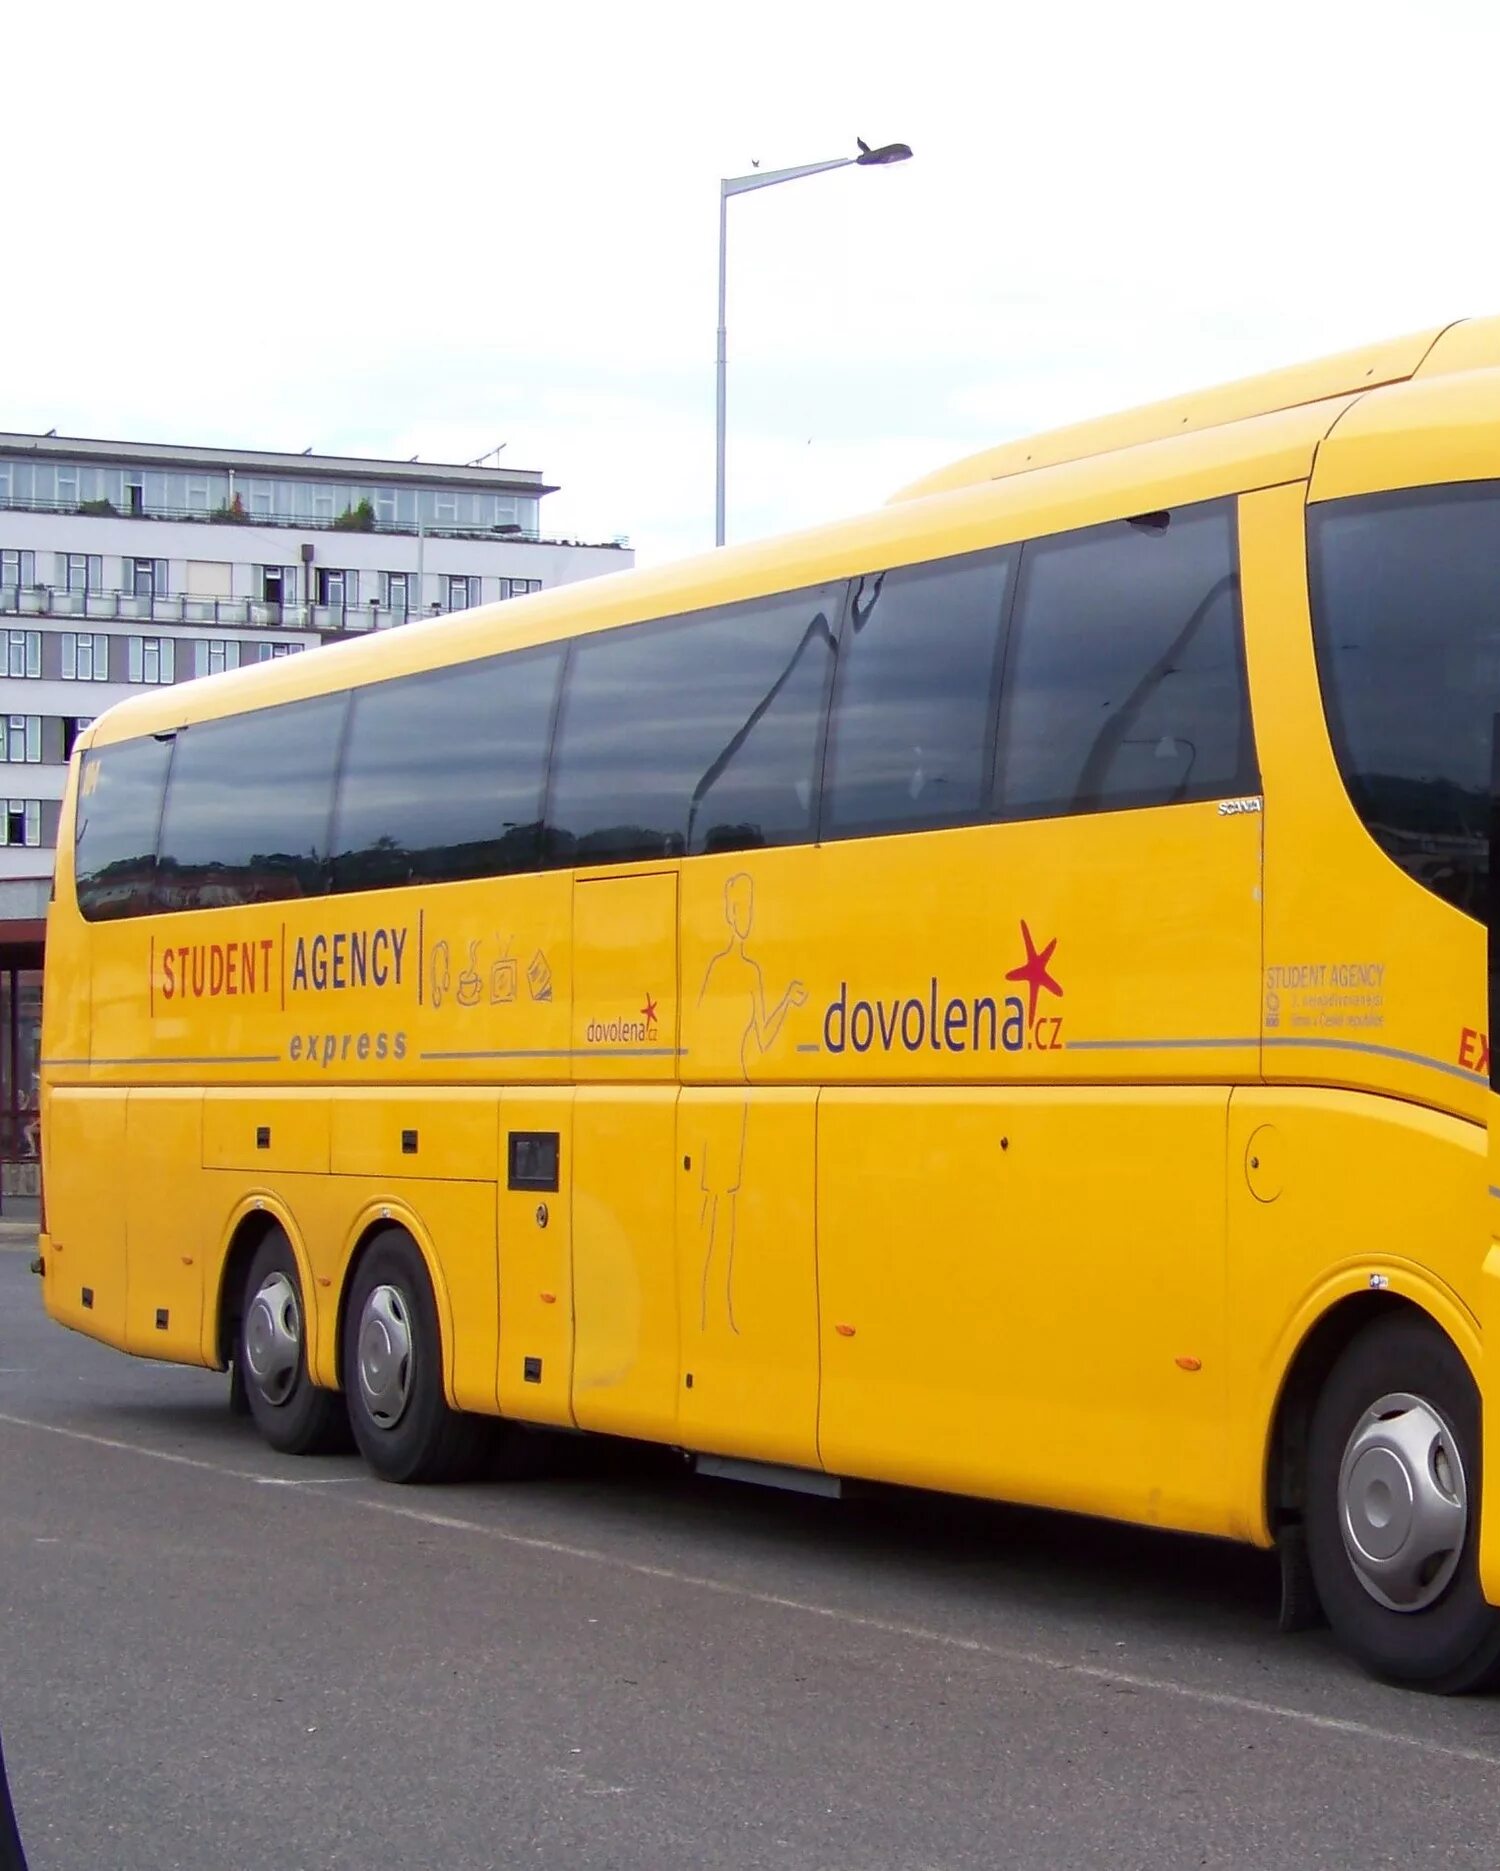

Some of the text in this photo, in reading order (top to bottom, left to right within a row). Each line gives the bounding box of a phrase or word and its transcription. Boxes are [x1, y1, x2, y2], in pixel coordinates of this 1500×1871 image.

[162, 927, 408, 1000] STUDENT AGENCY
[1266, 963, 1386, 989] STUDENT AGENCY
[289, 1030, 408, 1067] express
